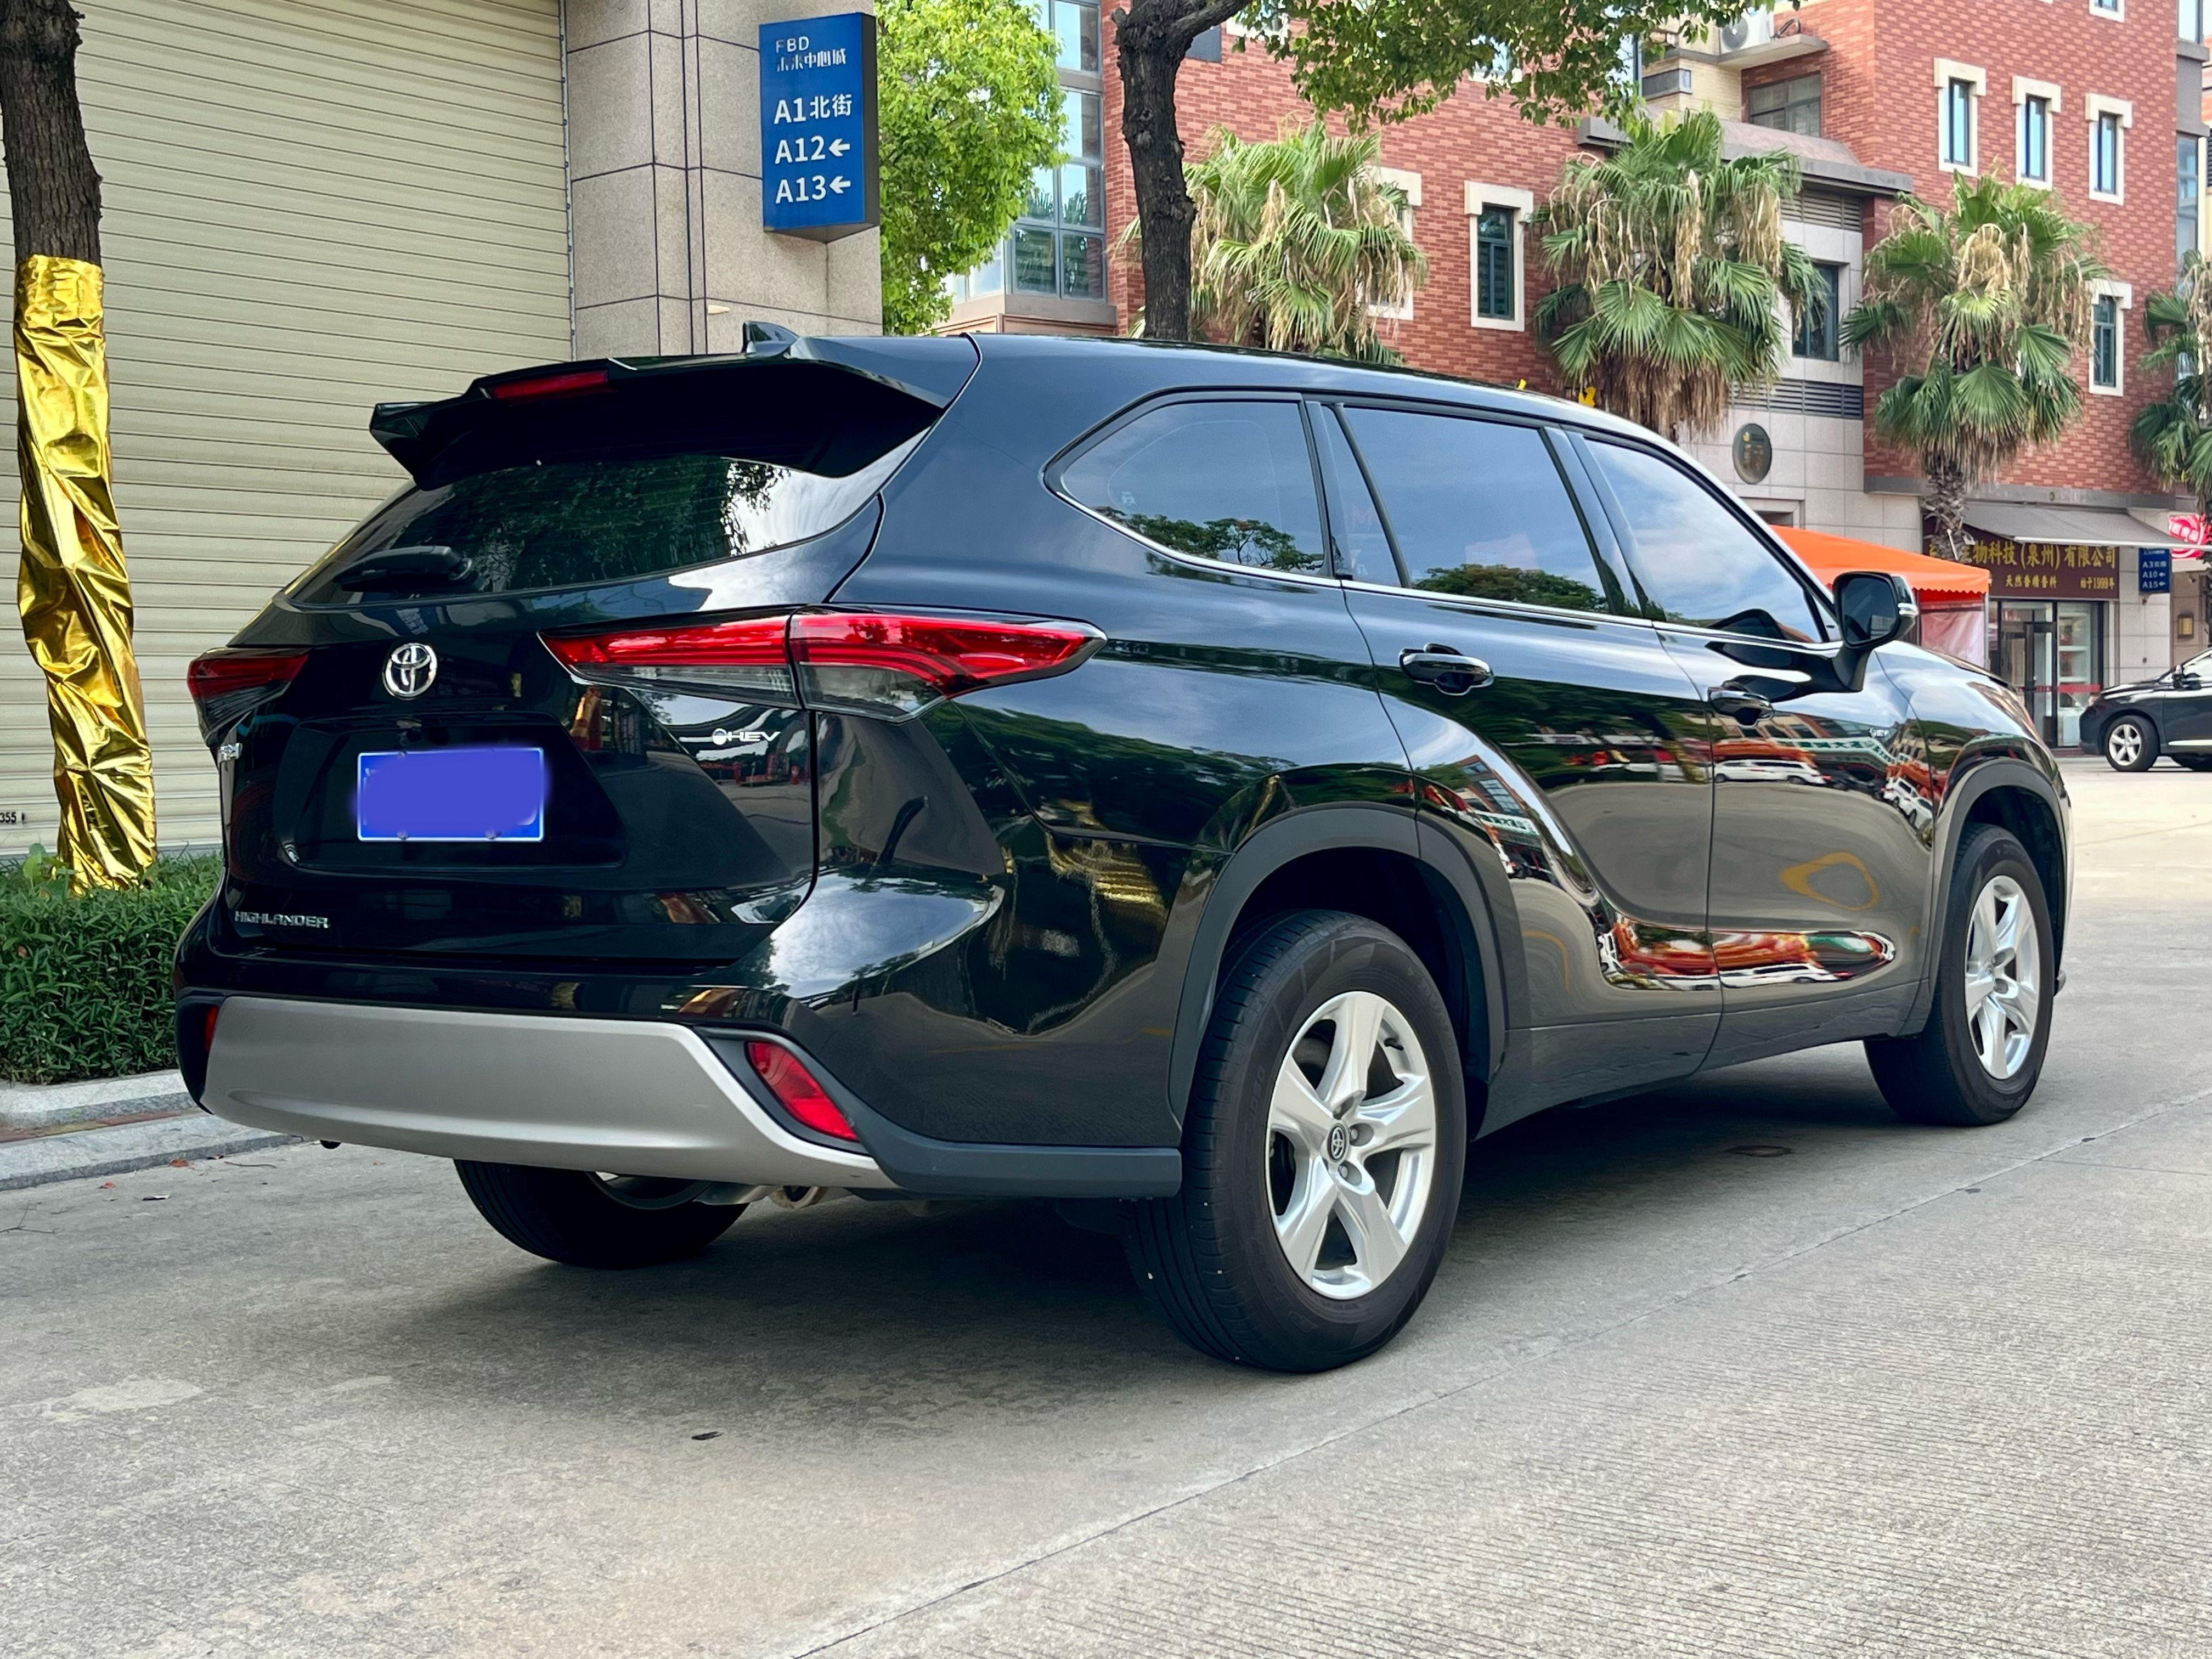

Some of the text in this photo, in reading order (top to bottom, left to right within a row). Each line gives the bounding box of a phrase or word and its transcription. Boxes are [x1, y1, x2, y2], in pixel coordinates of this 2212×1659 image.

[775, 36, 810, 53] FBD
[775, 136, 826, 164] A12
[775, 176, 826, 204] A13
[727, 730, 781, 742] HEV
[234, 911, 329, 929] HIGHLANDER
